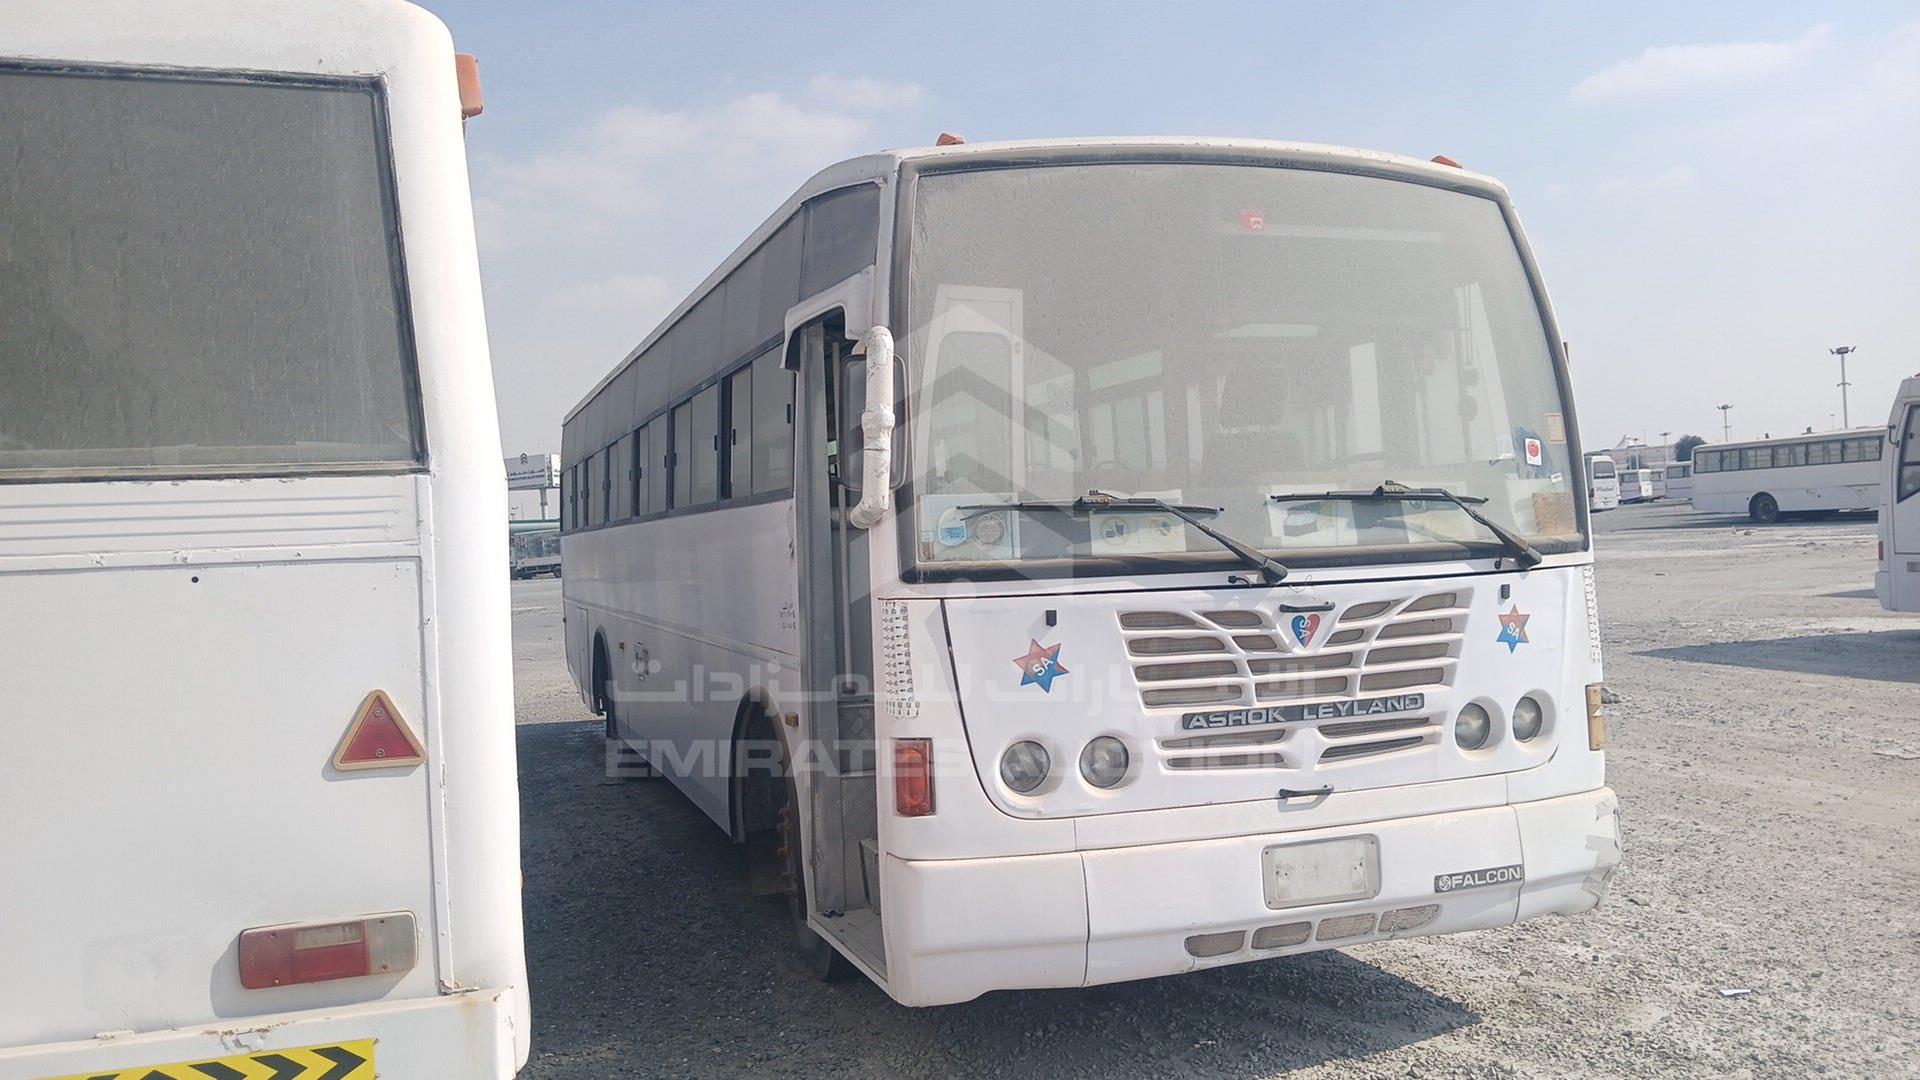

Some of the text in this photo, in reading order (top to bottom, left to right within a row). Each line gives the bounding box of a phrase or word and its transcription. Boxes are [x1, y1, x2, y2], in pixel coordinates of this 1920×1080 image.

[1299, 619, 1311, 640] SA
[1507, 622, 1520, 641] SA
[1032, 656, 1054, 677] SA
[1188, 695, 1421, 729] ASHOK LEYLAND
[1452, 866, 1521, 889] FALCON
